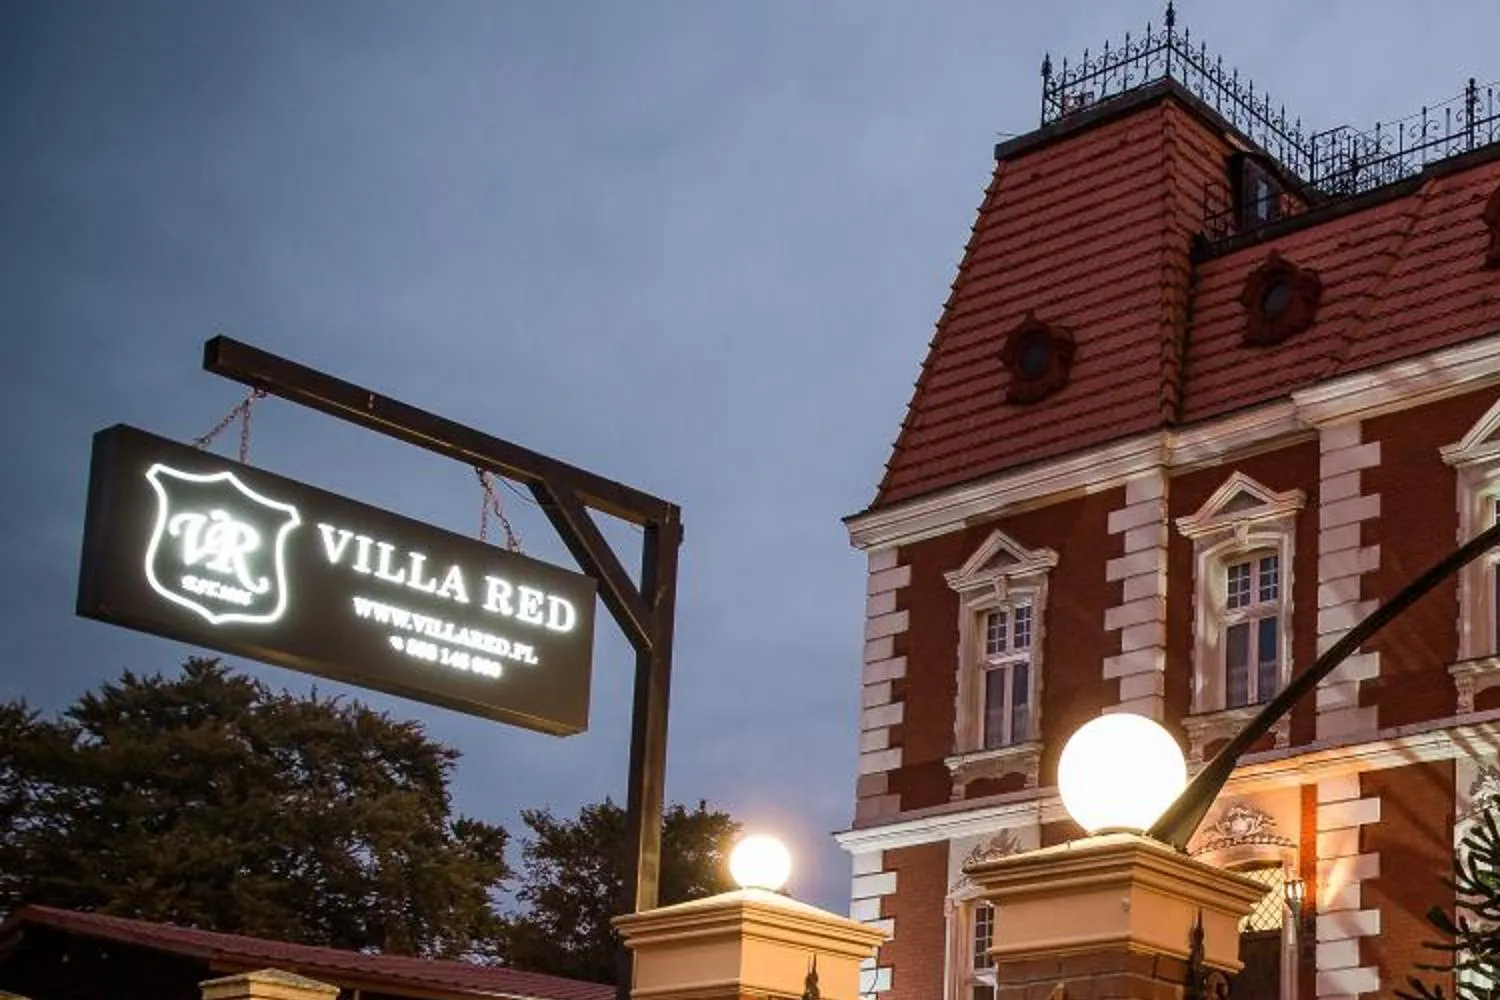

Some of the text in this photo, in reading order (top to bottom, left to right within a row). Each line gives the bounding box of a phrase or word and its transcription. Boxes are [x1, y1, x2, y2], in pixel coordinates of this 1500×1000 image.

[168, 508, 270, 594] VR
[317, 523, 470, 603] VILLA
[482, 575, 577, 632] RED
[352, 597, 539, 665] WWW.VILLARED.PL
